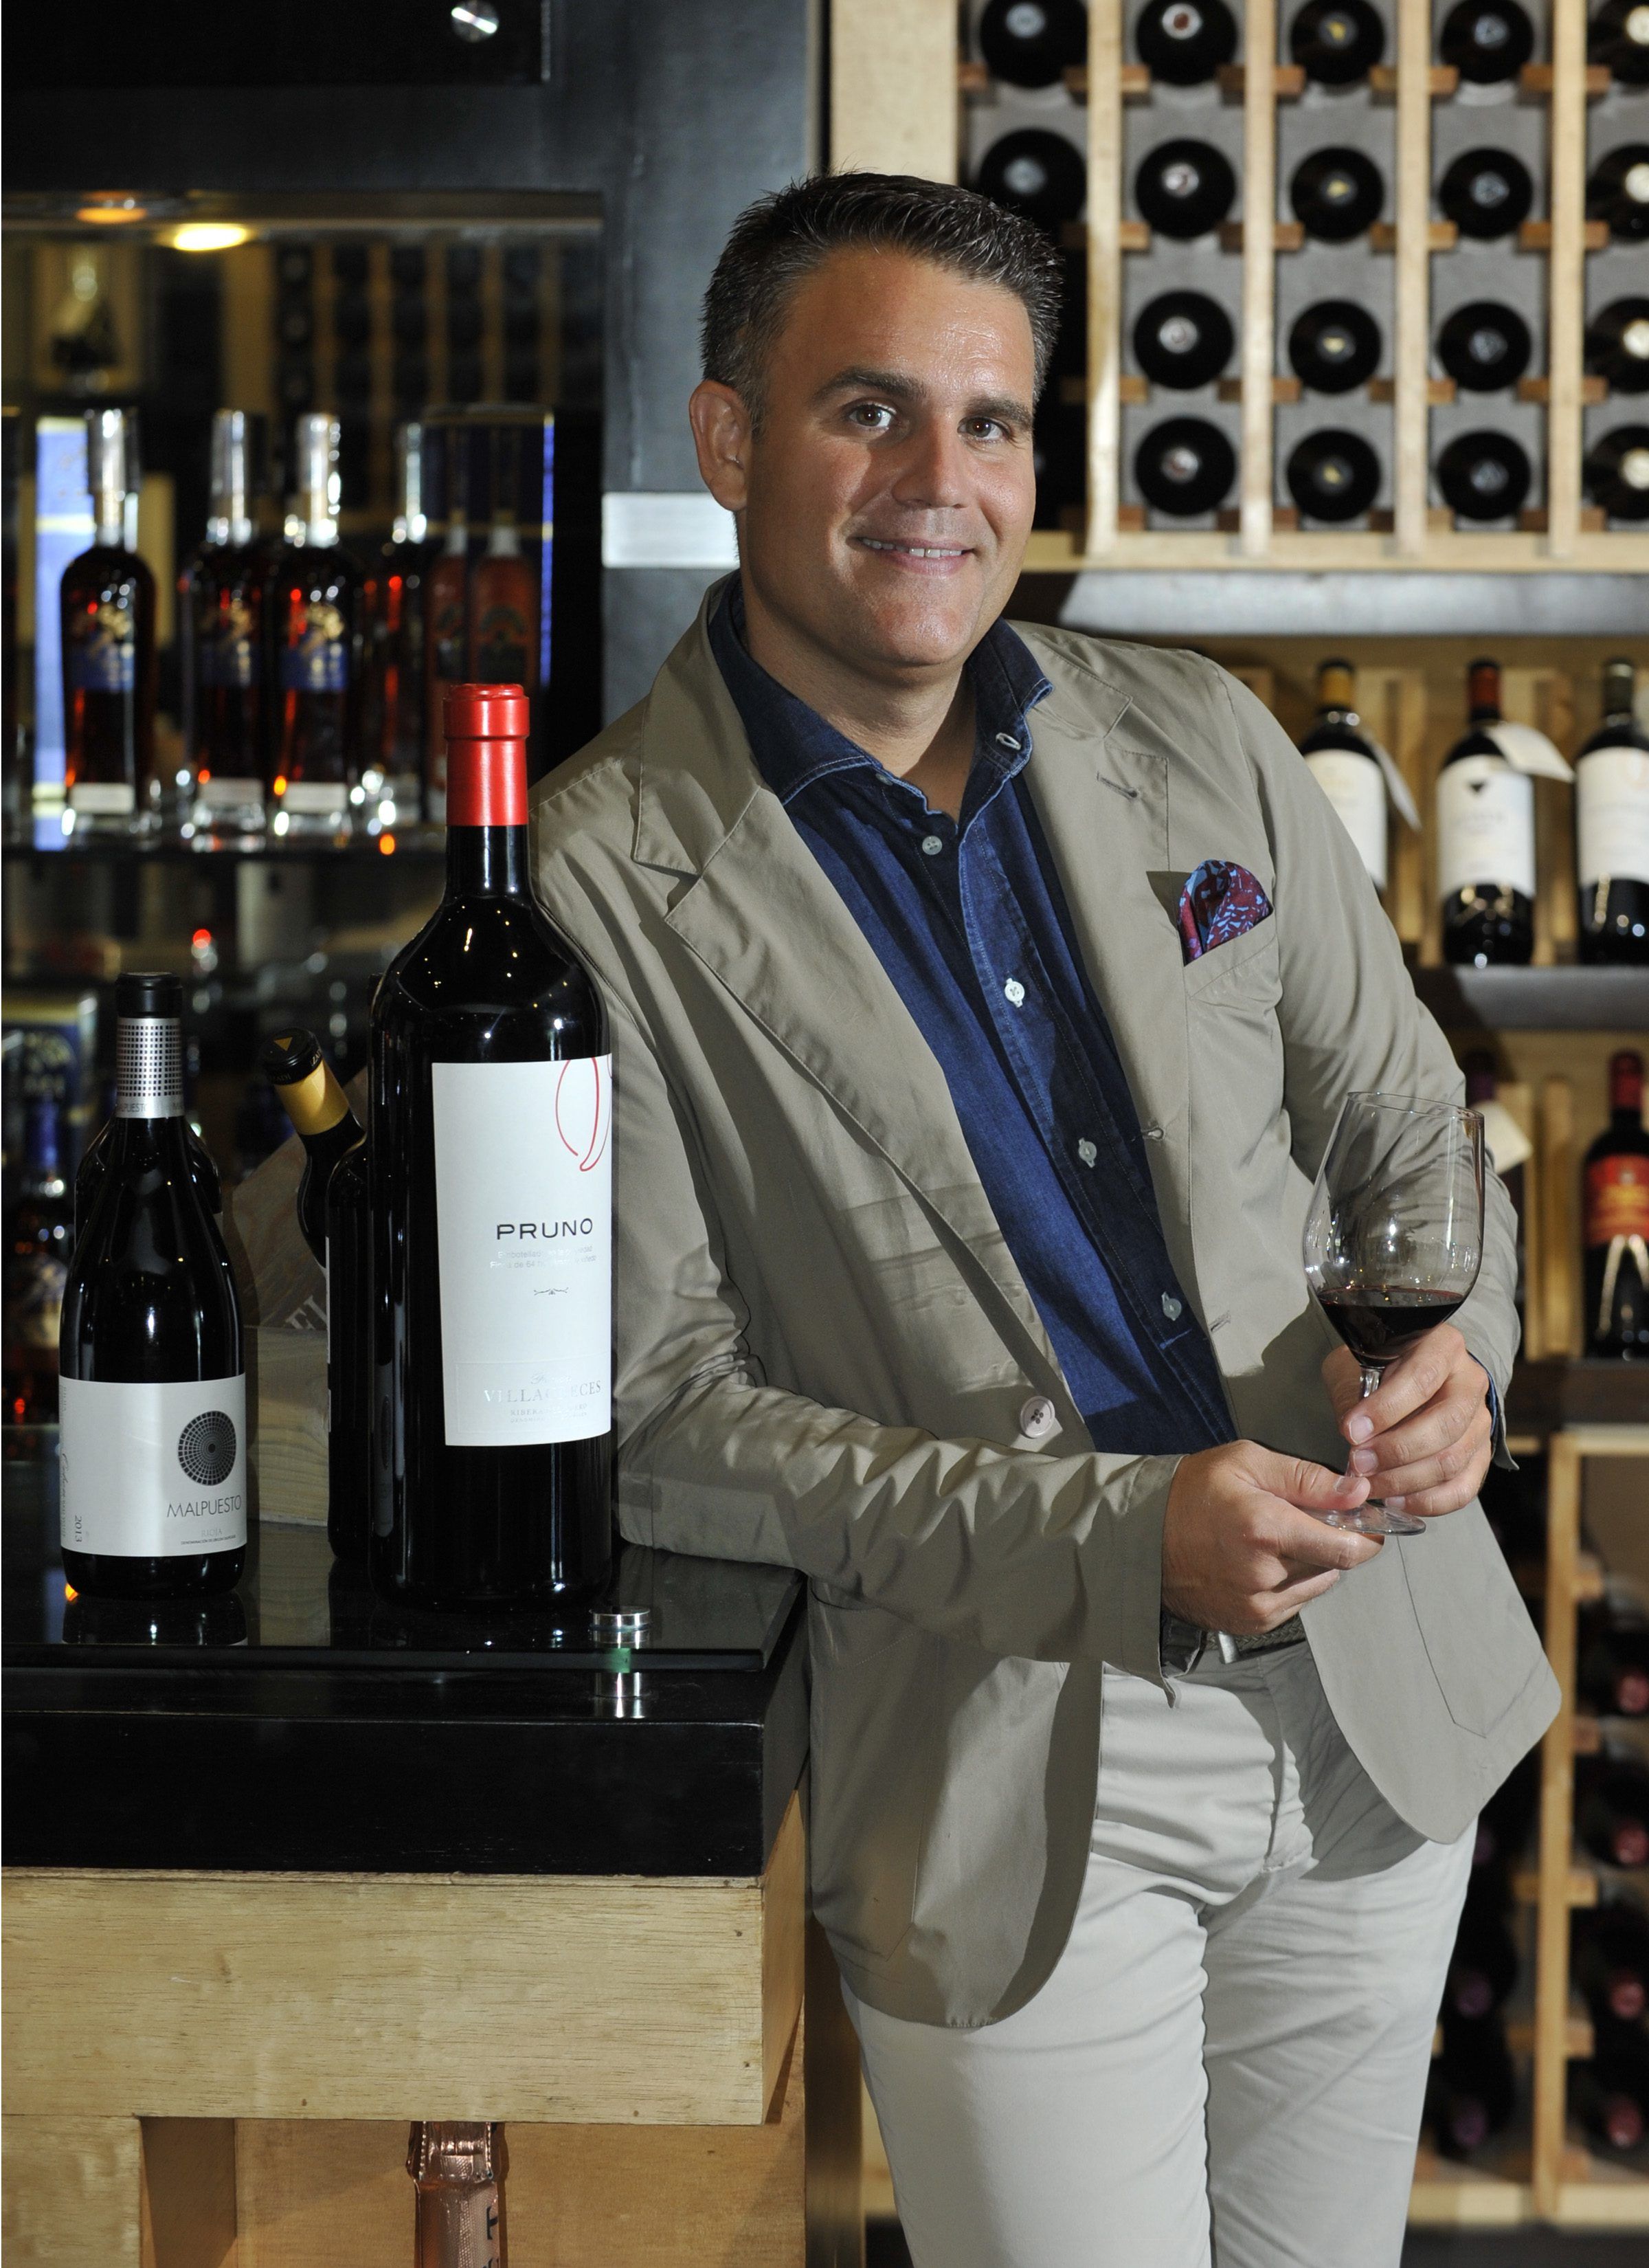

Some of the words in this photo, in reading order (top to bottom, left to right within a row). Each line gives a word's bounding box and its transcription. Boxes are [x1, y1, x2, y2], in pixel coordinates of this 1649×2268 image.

[497, 1218, 594, 1241] PRUNO
[484, 1380, 602, 1403] VILLACECES
[166, 1495, 242, 1518] MALPUESTO
[75, 1515, 83, 1543] 2013
[201, 1528, 223, 1537] RIOJA
